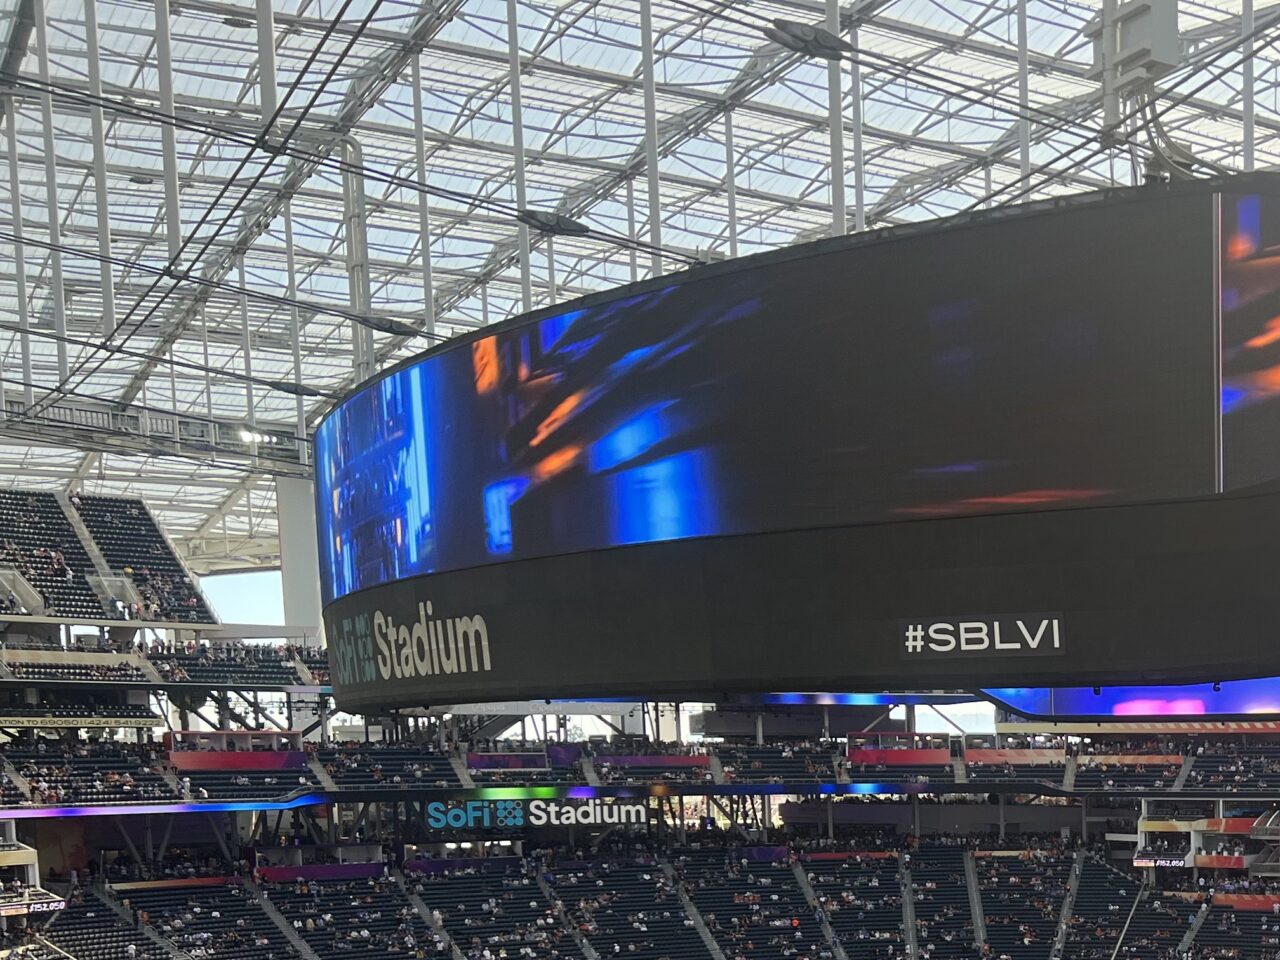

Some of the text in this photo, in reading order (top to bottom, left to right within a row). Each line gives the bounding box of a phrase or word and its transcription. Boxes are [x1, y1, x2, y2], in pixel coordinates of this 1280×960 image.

[333, 600, 491, 685] SoFi Stadium
[905, 619, 1060, 652] #SBLVI
[427, 799, 646, 828] SoFi Stadium
